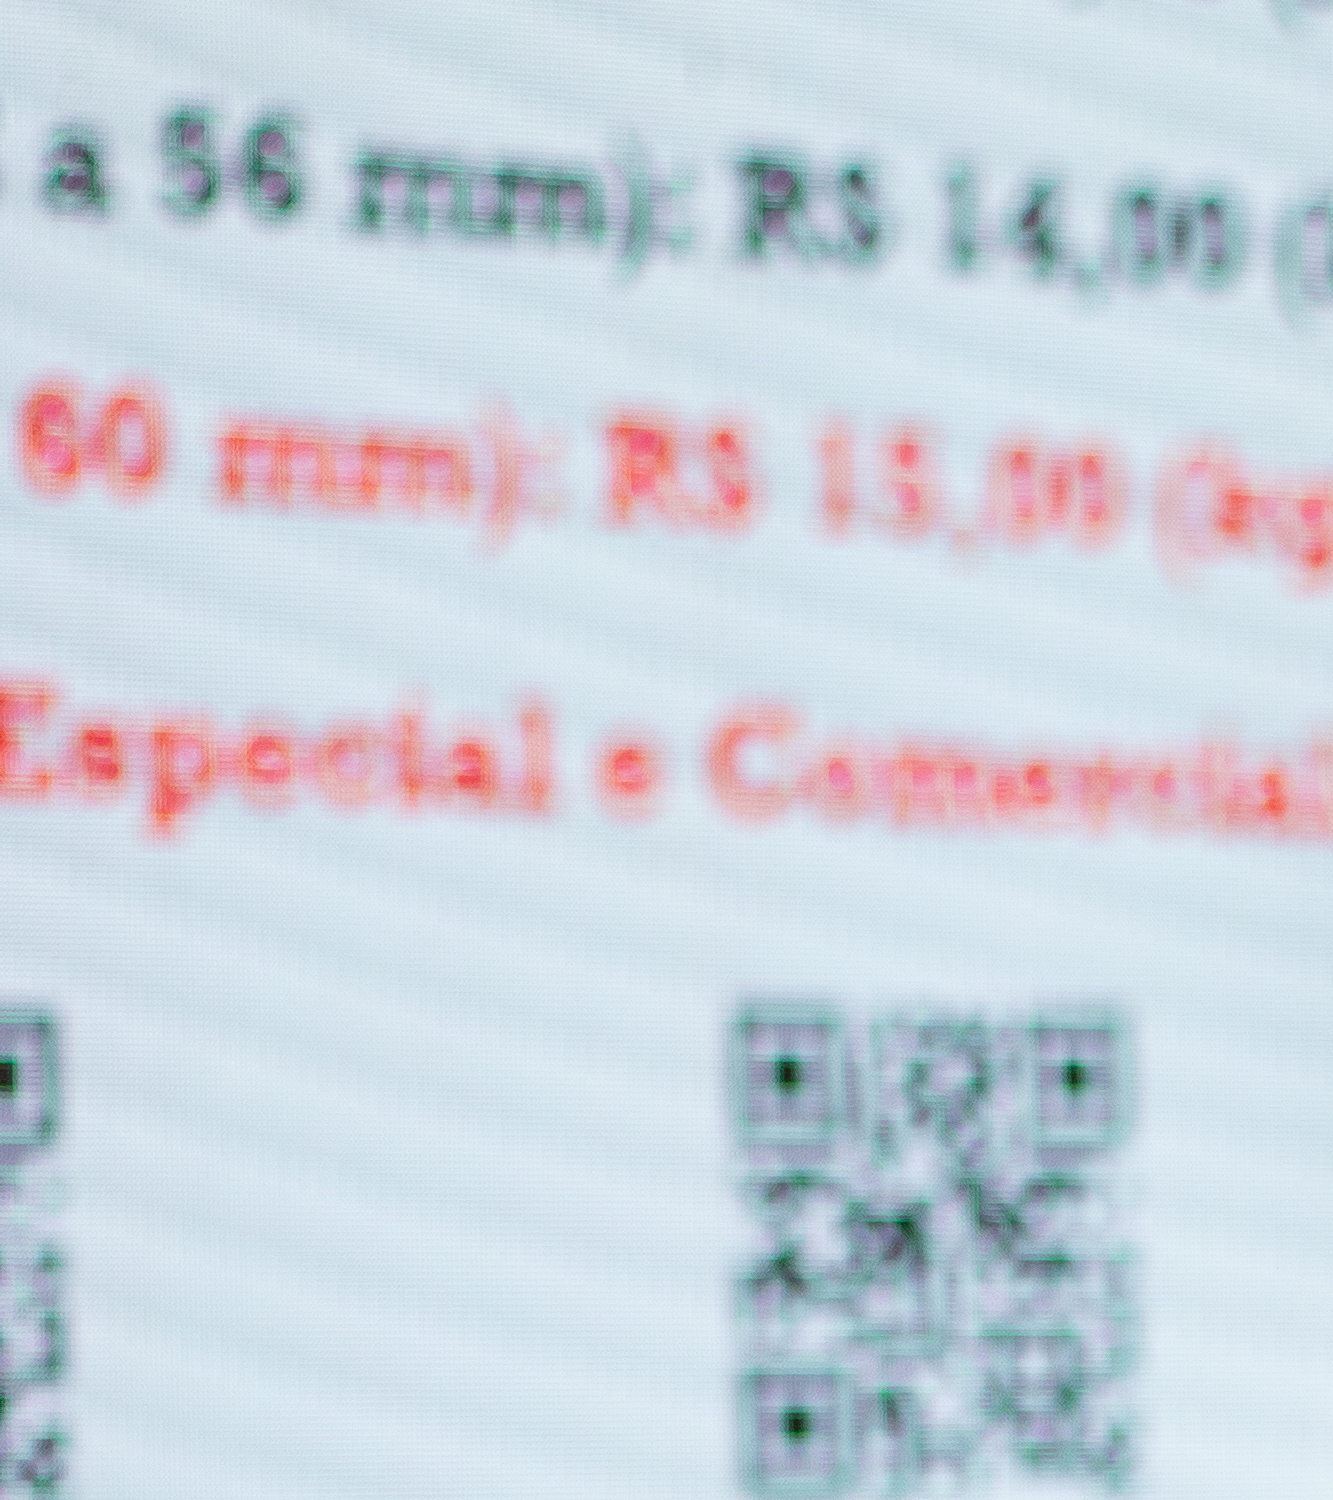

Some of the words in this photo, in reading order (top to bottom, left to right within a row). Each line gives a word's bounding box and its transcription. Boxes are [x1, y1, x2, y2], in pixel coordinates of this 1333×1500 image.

[40, 122, 110, 216] a
[159, 103, 307, 223] 56
[346, 138, 696, 276] mm):
[940, 160, 1249, 302] 14,00
[16, 379, 168, 501] 60
[0, 675, 556, 838] Especial
[595, 735, 661, 808] e
